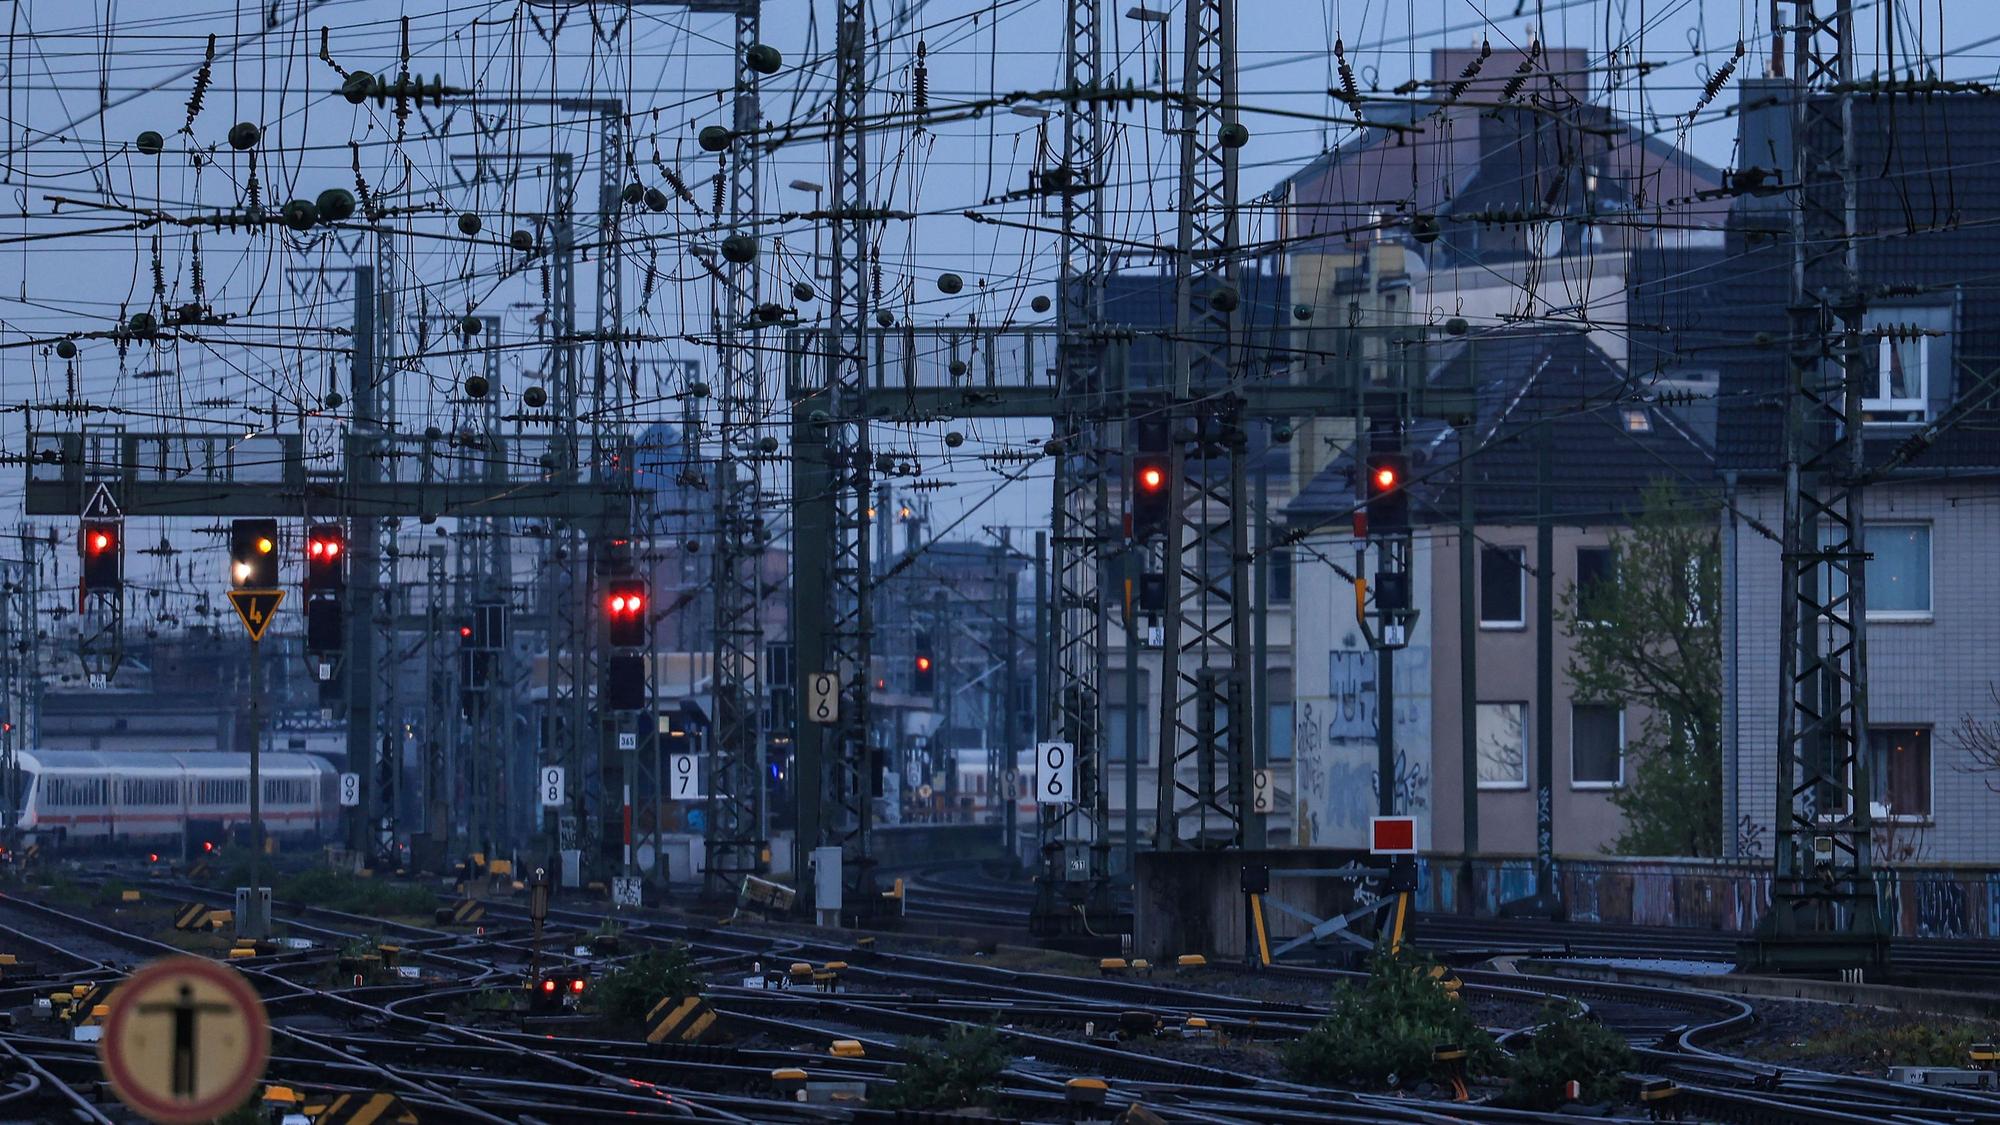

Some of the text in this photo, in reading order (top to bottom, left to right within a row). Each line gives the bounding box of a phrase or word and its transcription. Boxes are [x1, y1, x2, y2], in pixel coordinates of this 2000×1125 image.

[250, 598, 262, 624] 4
[815, 676, 831, 696] 0
[817, 699, 830, 719] 6
[677, 757, 691, 774] 0
[1046, 747, 1064, 769] 0
[344, 776, 353, 787] 0
[547, 770, 558, 785] 0
[679, 776, 690, 795] 7
[1047, 772, 1063, 796] 6
[1254, 772, 1267, 789] 0
[548, 786, 558, 801] 8
[1255, 791, 1266, 809] 6
